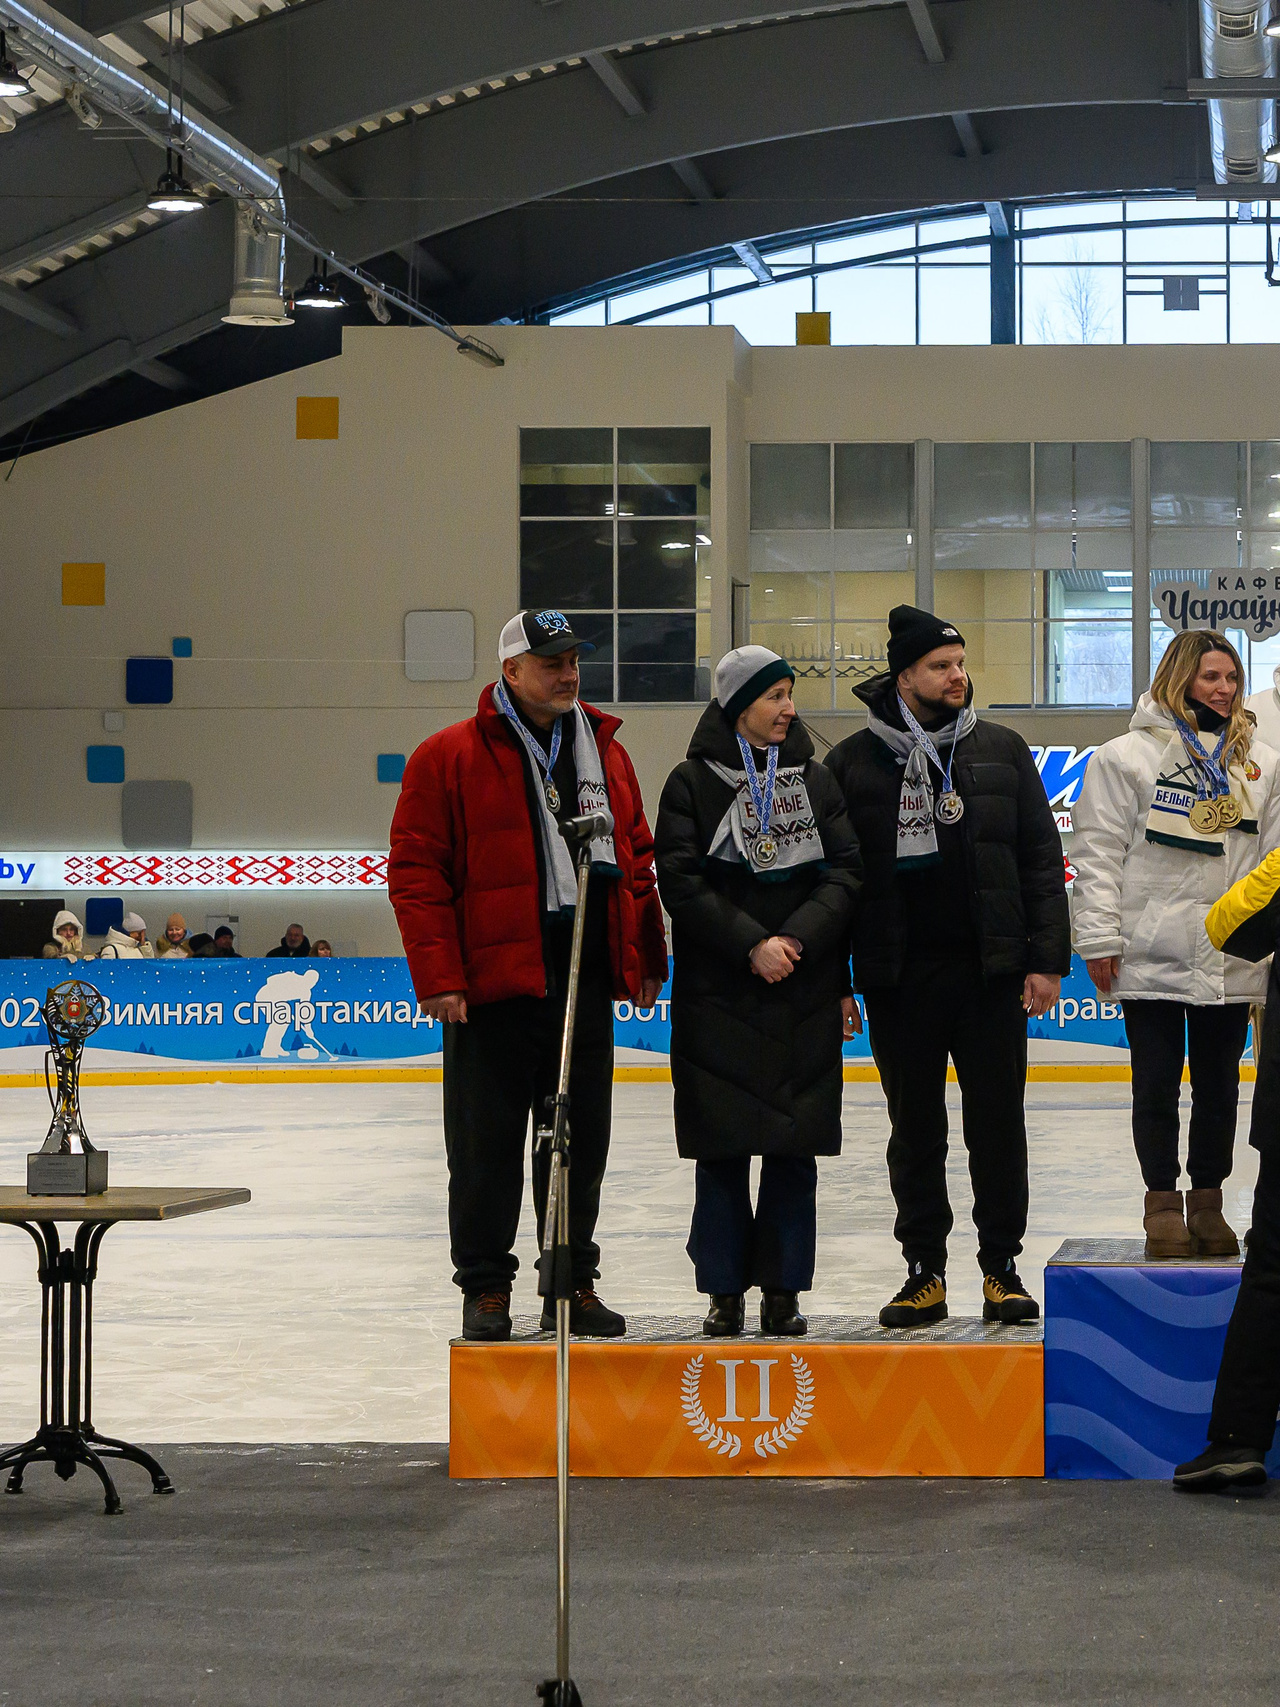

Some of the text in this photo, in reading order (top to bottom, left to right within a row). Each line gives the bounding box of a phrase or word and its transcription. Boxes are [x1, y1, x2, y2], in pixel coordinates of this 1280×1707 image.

[1155, 789, 1192, 808] БЕЛЫЕ
[0, 997, 48, 1028] 02
[233, 1000, 441, 1031] спартакиад
[715, 1359, 780, 1422] II
